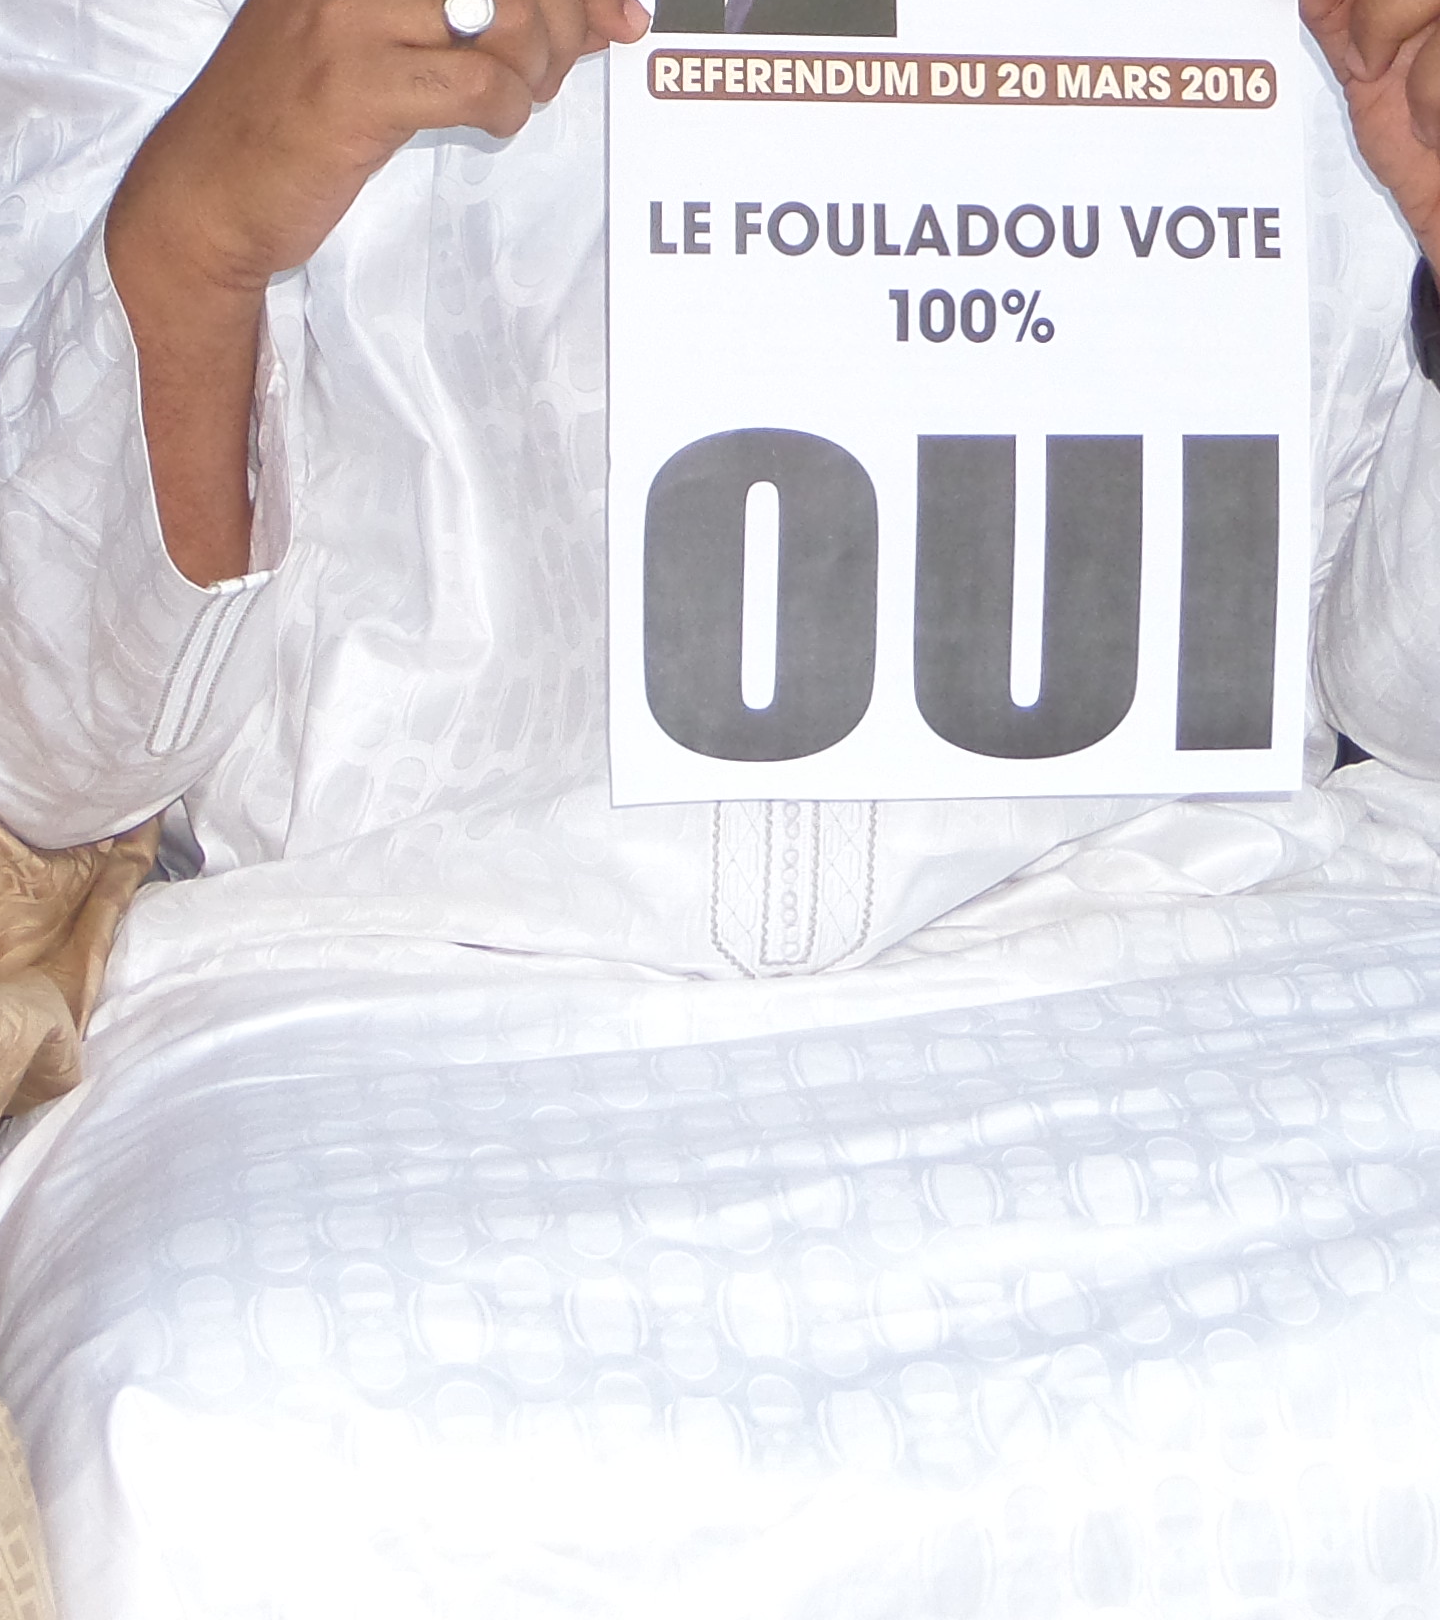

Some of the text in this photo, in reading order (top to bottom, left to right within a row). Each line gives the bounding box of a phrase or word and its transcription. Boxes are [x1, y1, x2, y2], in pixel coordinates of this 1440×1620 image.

[656, 58, 1270, 101] REFERENDUM DU 20 MARS 2016
[651, 202, 1280, 259] LE FOULADOU VOTE
[889, 289, 1054, 343] 100%
[644, 428, 1279, 762] OUI
